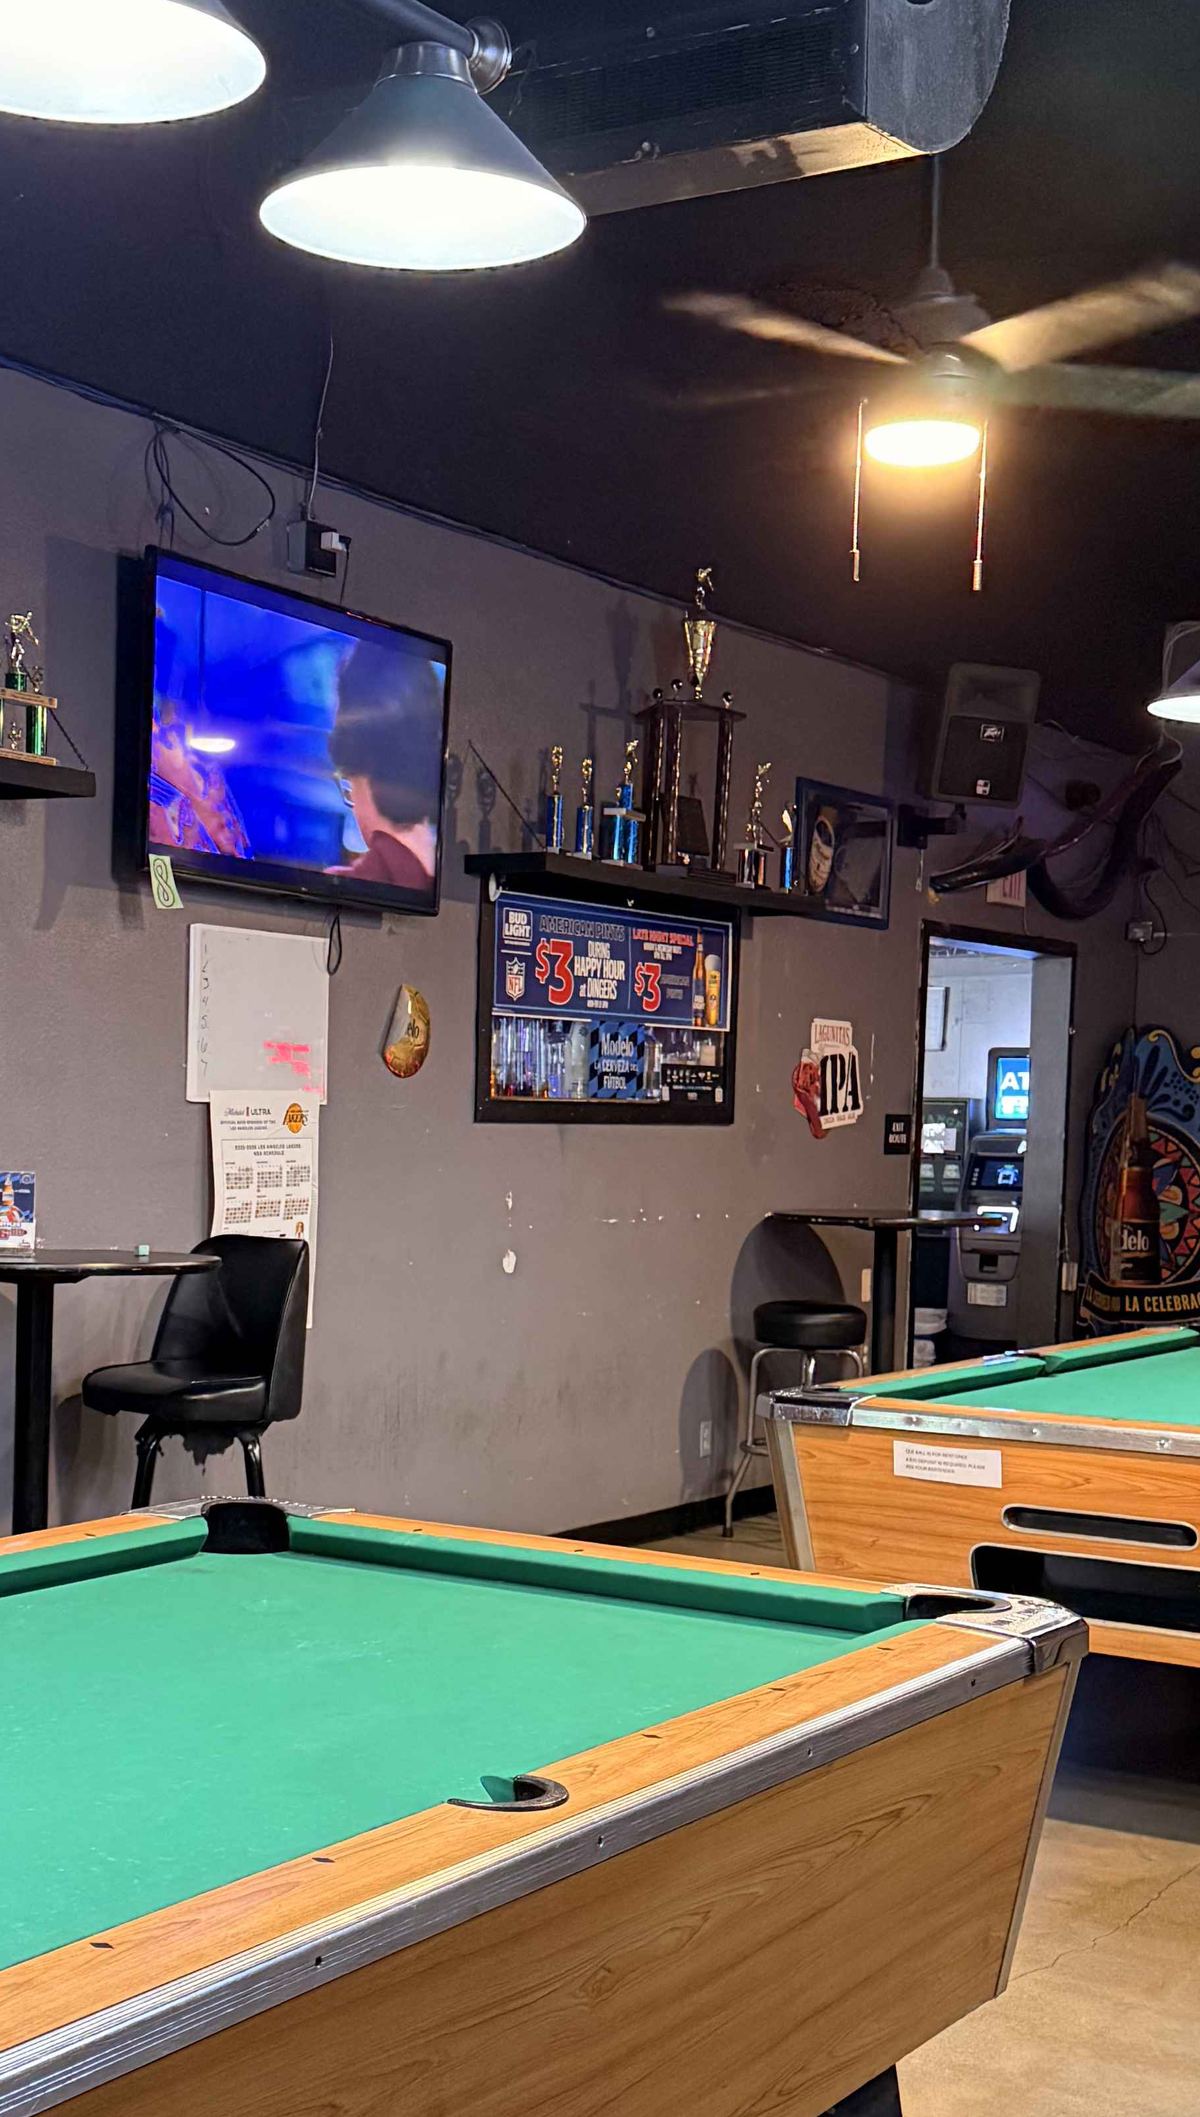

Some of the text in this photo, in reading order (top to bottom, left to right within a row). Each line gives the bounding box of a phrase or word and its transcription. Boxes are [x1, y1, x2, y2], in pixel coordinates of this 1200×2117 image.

[153, 858, 176, 907] 8
[508, 911, 528, 924] BUD
[539, 914, 625, 942] AMERICAN PINTS
[504, 923, 531, 938] LIGHT
[588, 940, 610, 959] DURING
[535, 938, 574, 1006] $3
[574, 955, 626, 981] HAPPY HOUR
[587, 978, 618, 1000] DINGERS
[634, 961, 662, 1012] $3
[601, 1032, 634, 1057] Modelo
[815, 1023, 850, 1046] LAGUNITAS
[601, 1059, 630, 1073] CERVEZA
[603, 1073, 627, 1090] FÚTBOL
[819, 1051, 861, 1117] IPA
[1001, 1071, 1030, 1091] AT
[250, 1108, 272, 1116] ULTRA
[892, 1121, 904, 1132] EXIT
[889, 1133, 907, 1144] ROUTE
[1121, 1229, 1149, 1251] delo
[1125, 1295, 1140, 1312] LA
